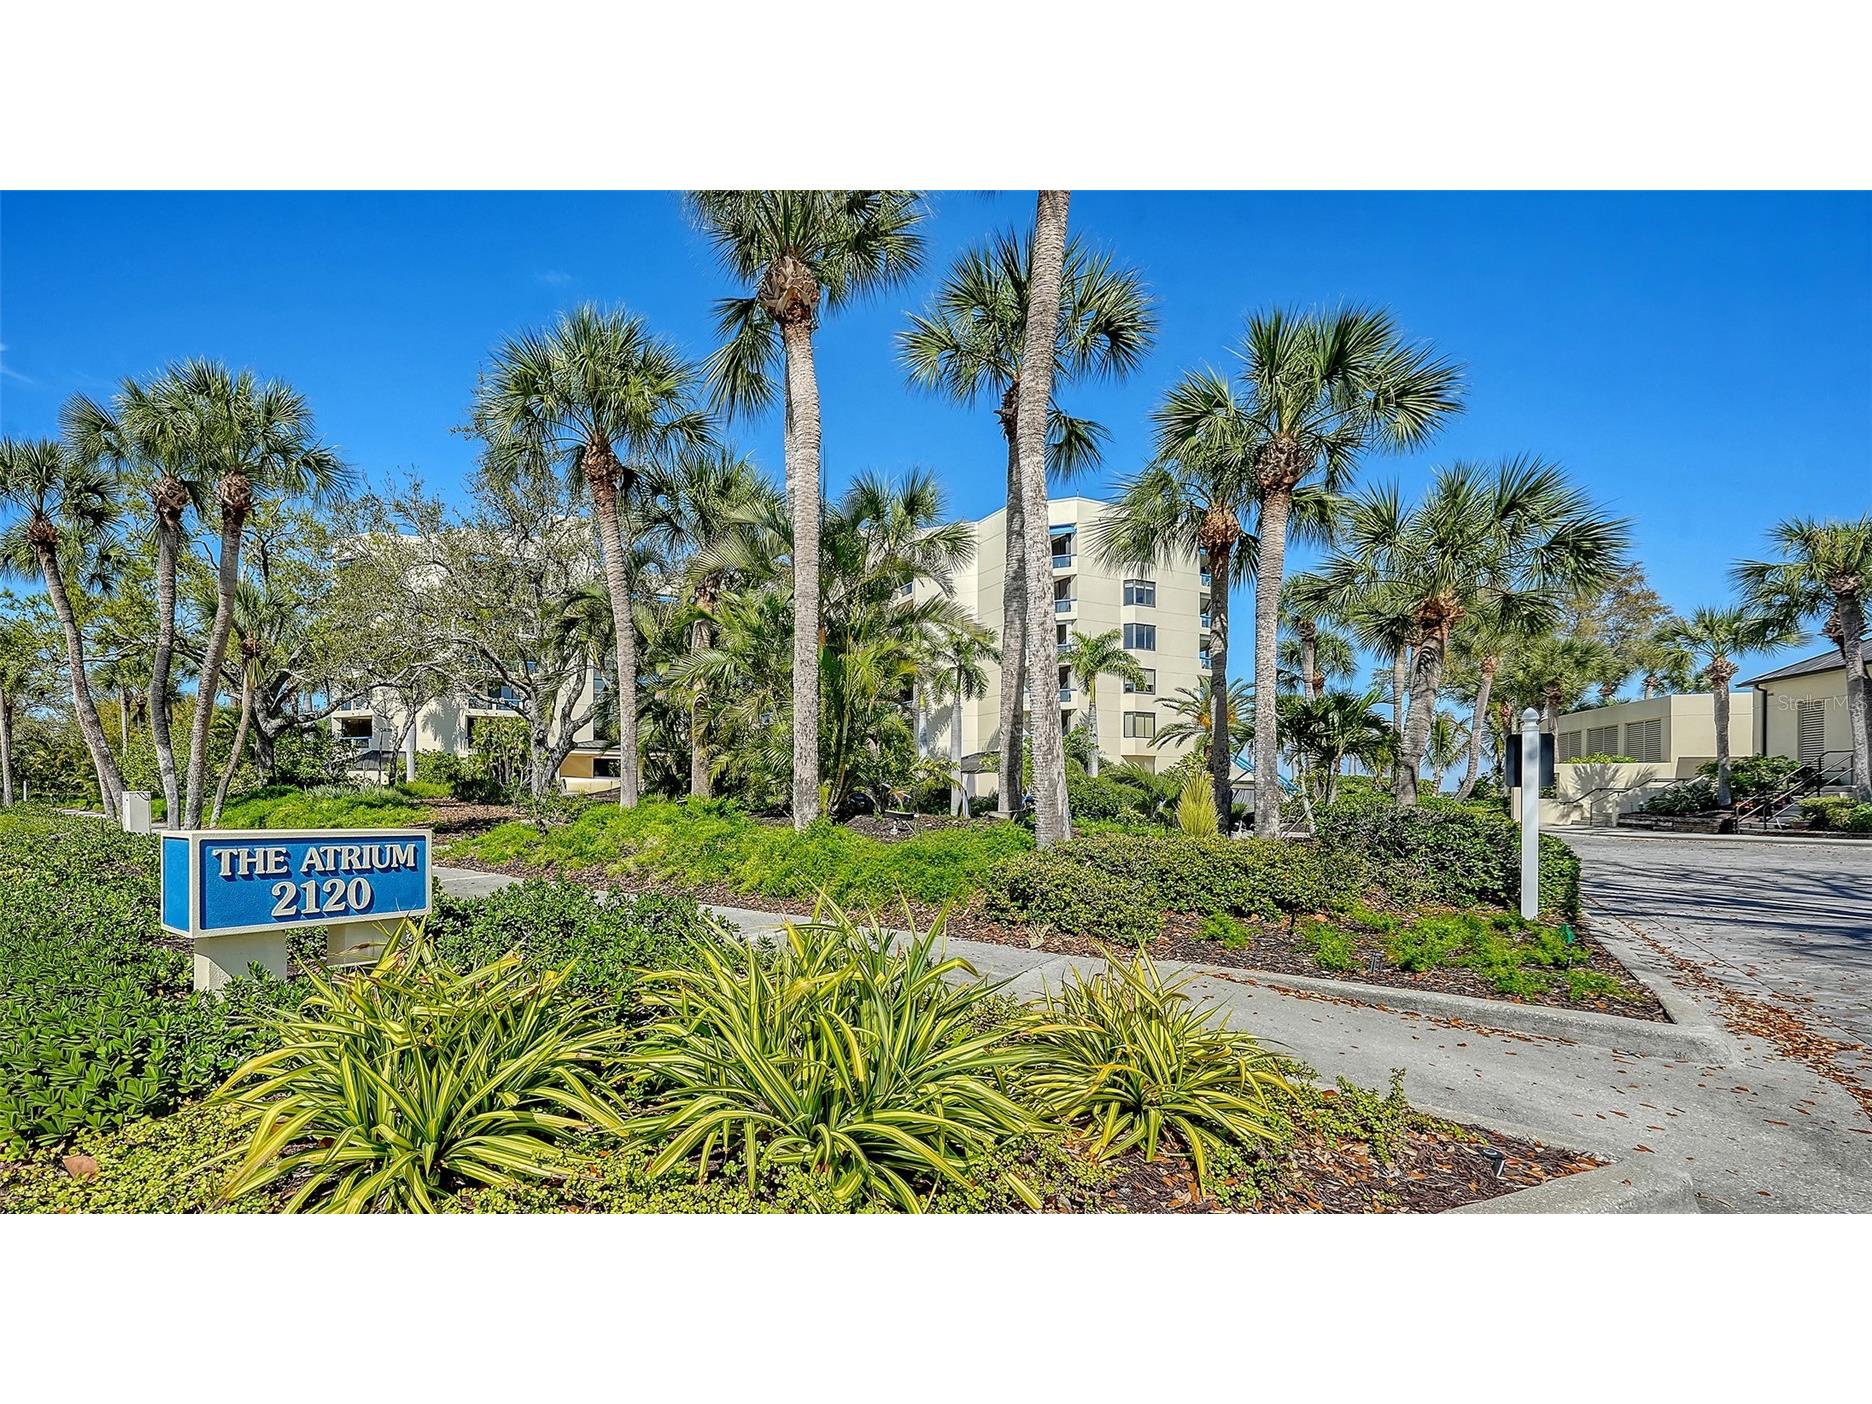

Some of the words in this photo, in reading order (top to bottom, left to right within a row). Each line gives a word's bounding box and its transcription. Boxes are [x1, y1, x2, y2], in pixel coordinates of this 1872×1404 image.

[212, 847, 289, 877] THE
[300, 843, 416, 873] ATRIUM
[271, 877, 372, 917] 2120
